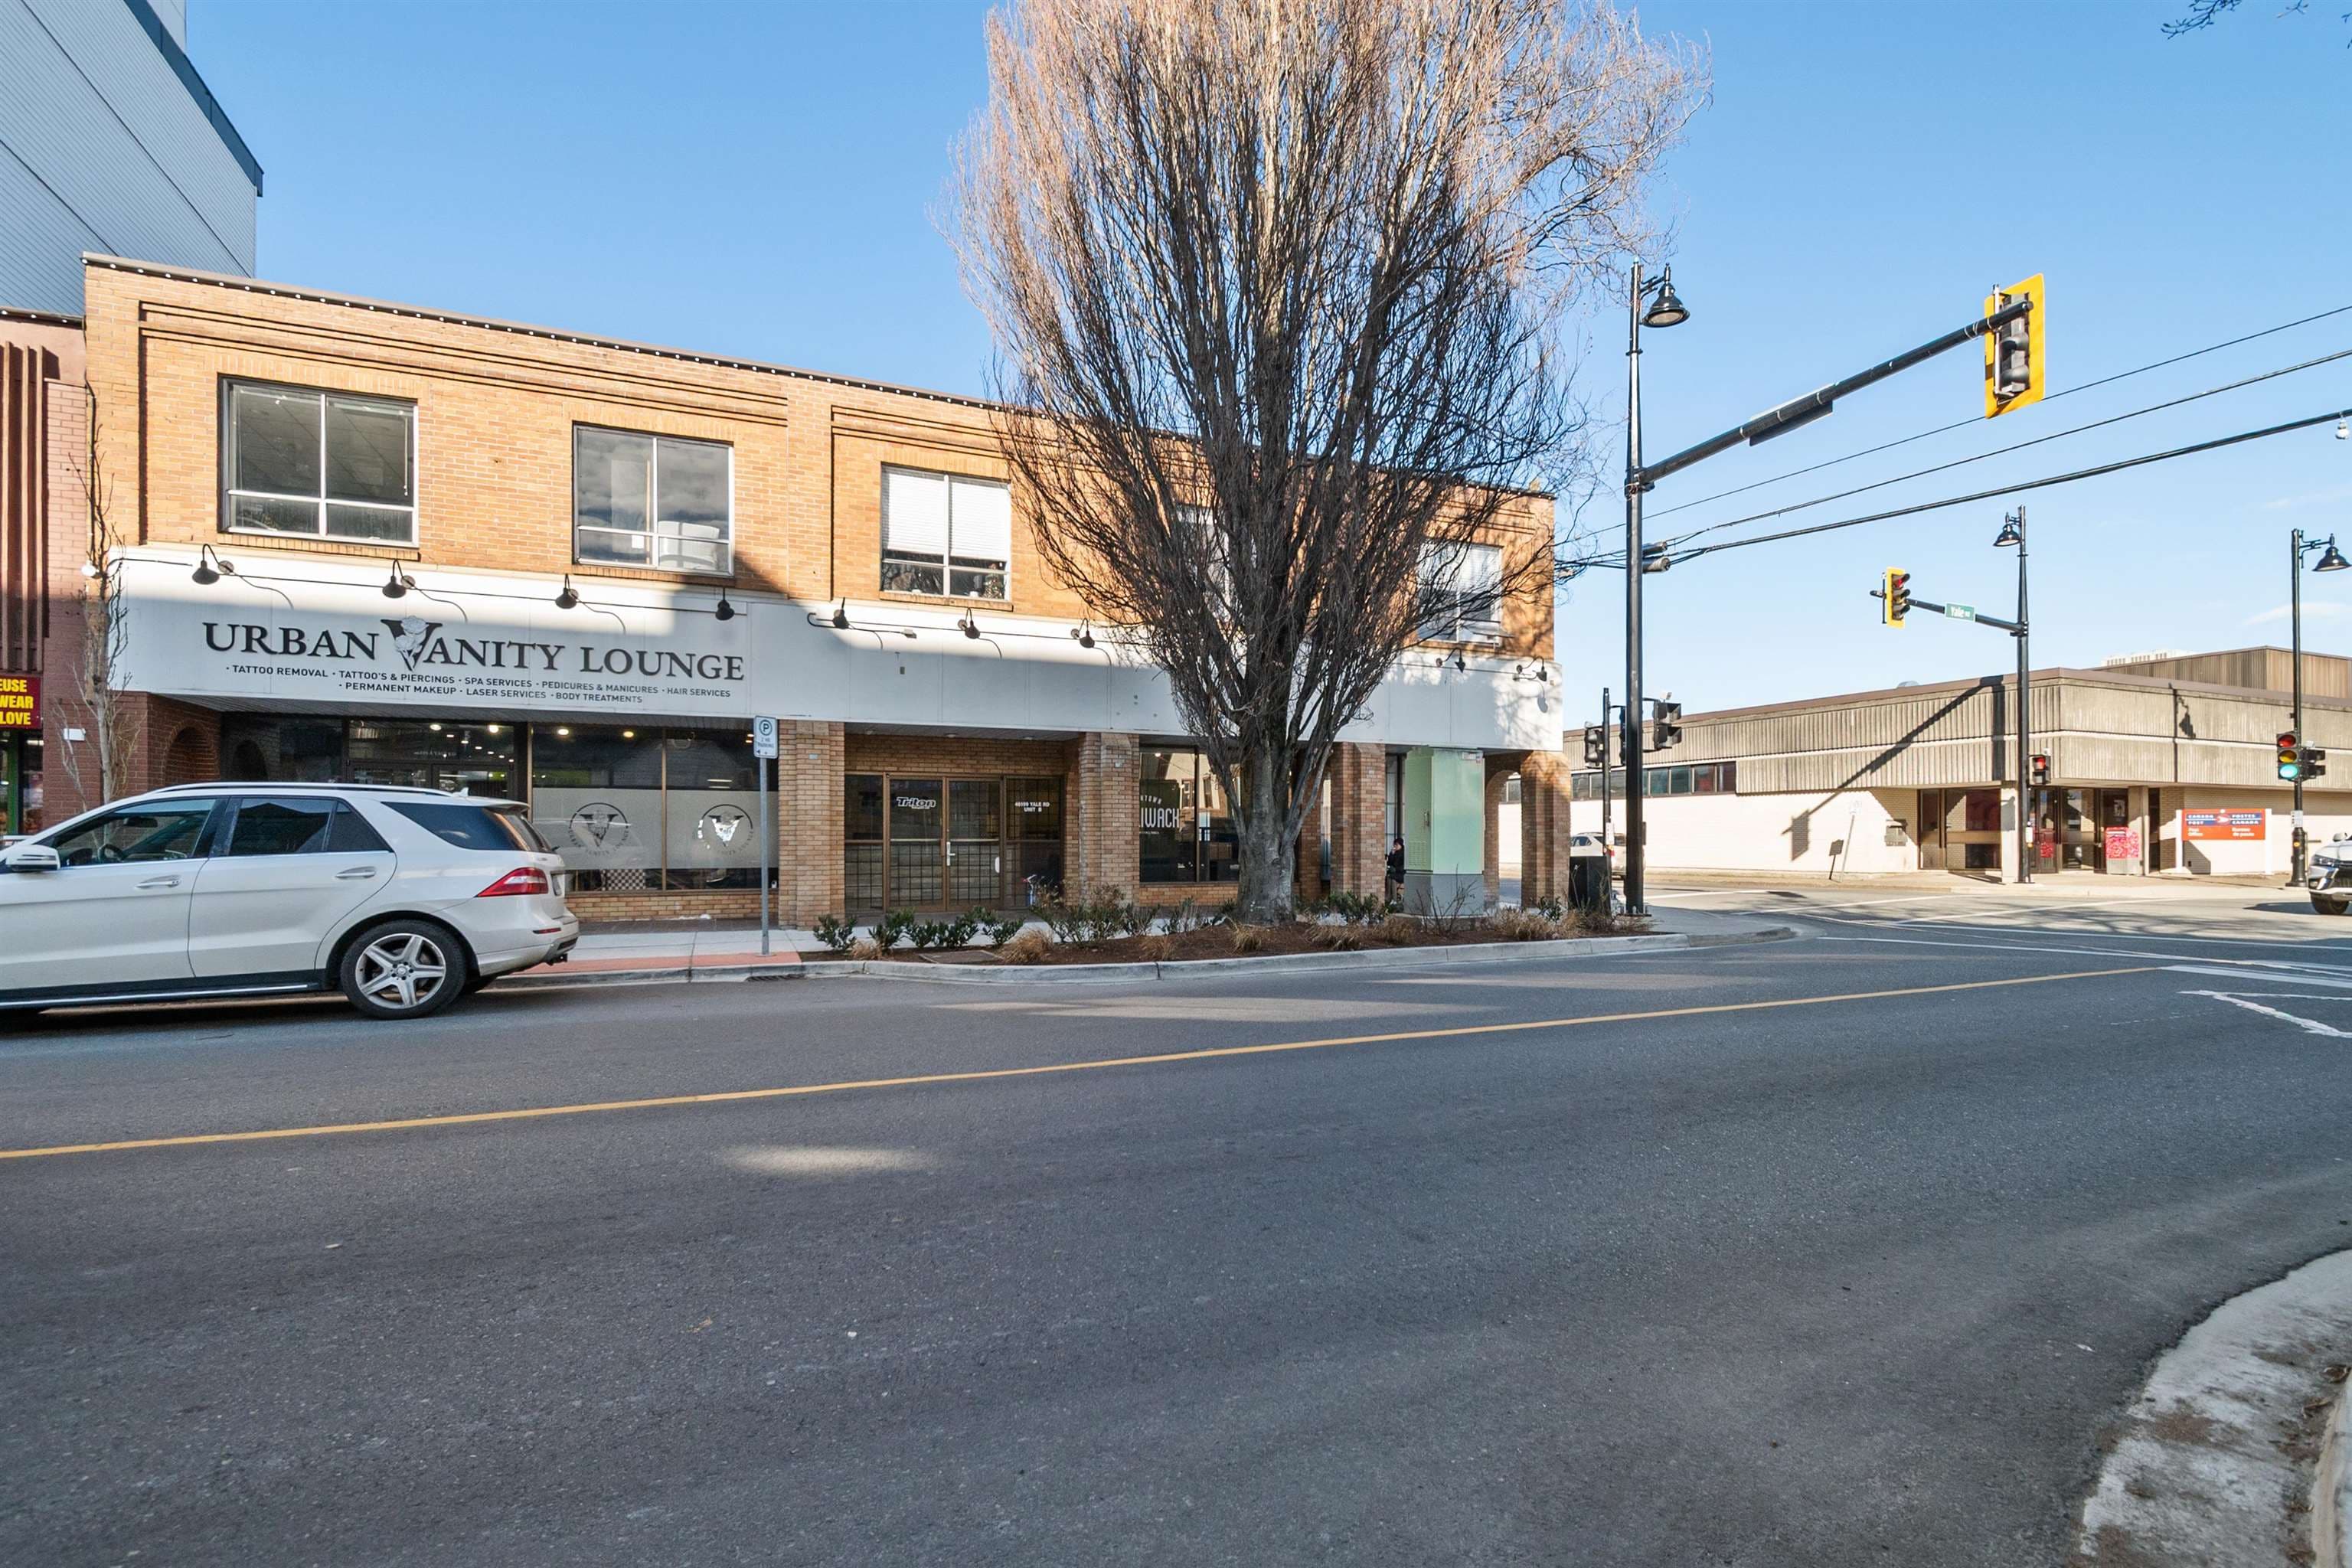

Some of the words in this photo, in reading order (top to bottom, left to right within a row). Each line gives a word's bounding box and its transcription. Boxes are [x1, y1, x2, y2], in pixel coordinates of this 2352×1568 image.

[1951, 606, 1964, 618] Yale
[202, 622, 379, 661] URBAN
[381, 617, 565, 671] VANITY
[580, 646, 744, 681] LOUNGE
[233, 665, 274, 675] TATTOO
[276, 667, 328, 678] REMOVAL
[338, 670, 387, 681] TATTOO'S
[390, 673, 398, 681] &
[400, 673, 456, 684] PIERCINGS
[465, 677, 484, 685] SPA
[486, 678, 533, 688] SERVICES
[541, 681, 594, 691] PEDICURES
[606, 684, 659, 694] MANICURES
[667, 687, 688, 695] HAIR
[690, 688, 731, 697] SERVICES
[345, 681, 411, 692] PERMANENT
[413, 685, 457, 694] MAKEUP
[466, 688, 498, 697] LASER
[500, 690, 547, 698] SERVICES
[556, 691, 580, 701] BODY
[583, 693, 643, 703] TREATMENTS
[0, 711, 31, 725] LOVE
[896, 796, 936, 808] Triton
[1138, 808, 1180, 828] IWACK
